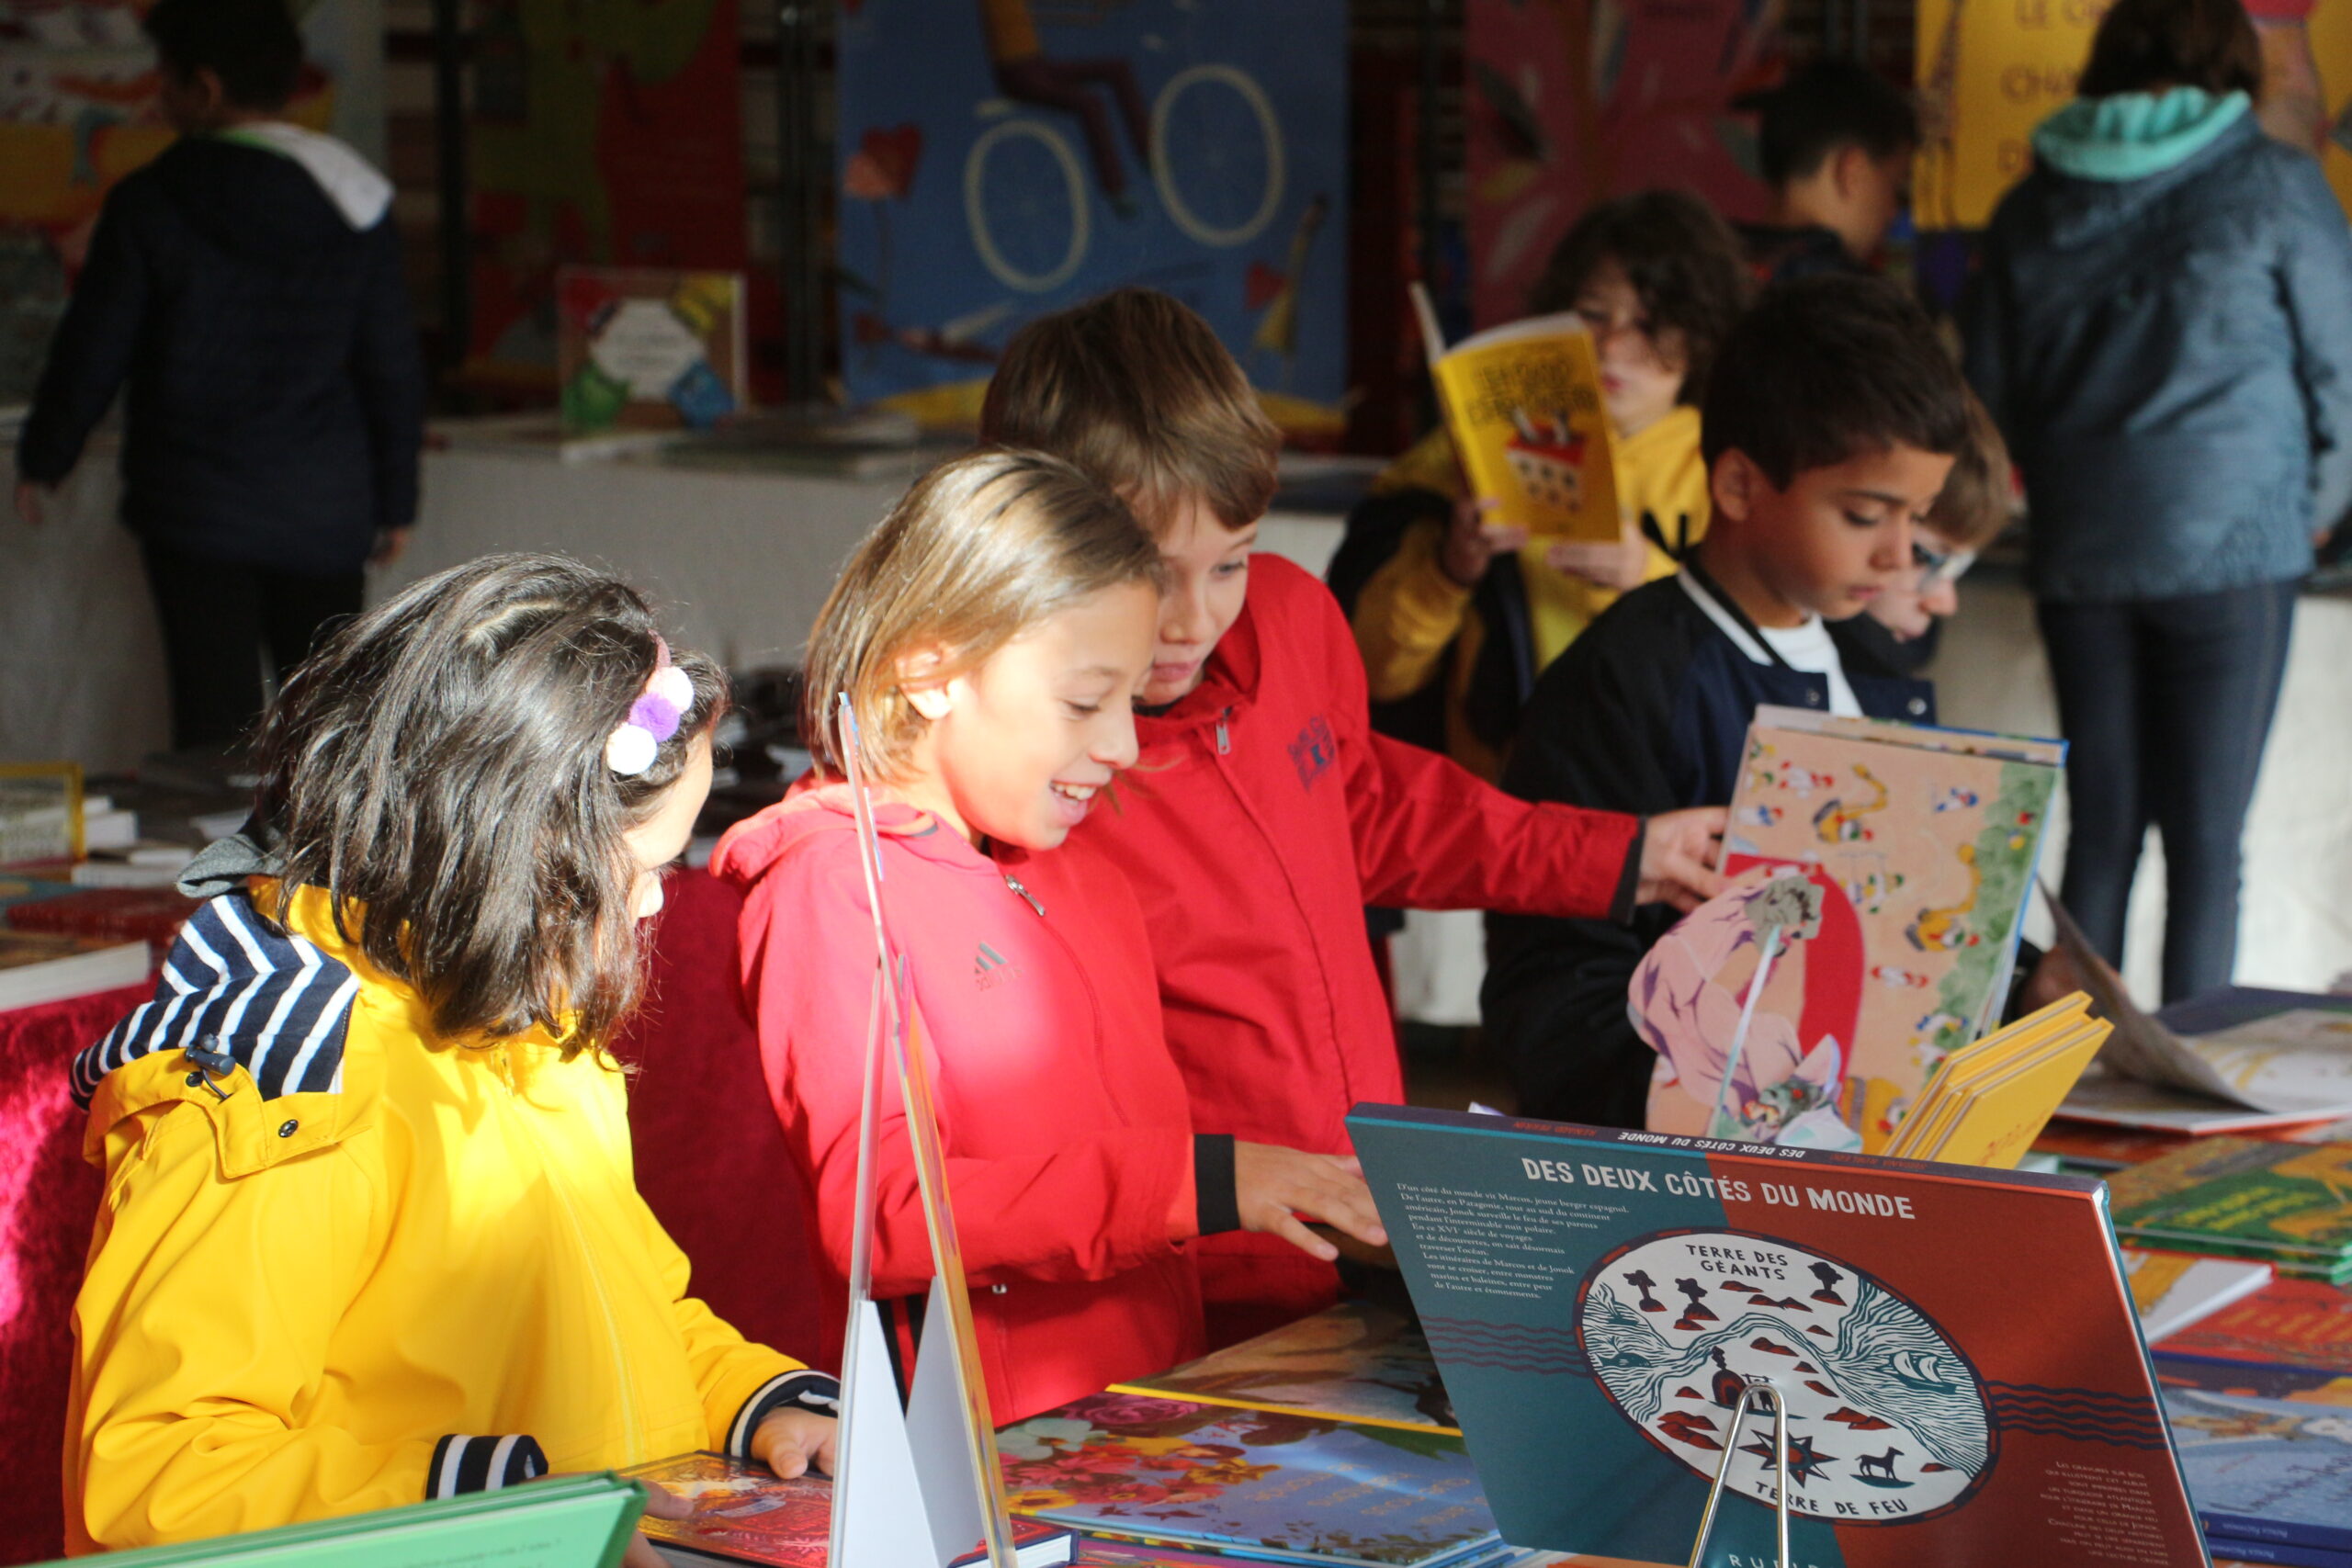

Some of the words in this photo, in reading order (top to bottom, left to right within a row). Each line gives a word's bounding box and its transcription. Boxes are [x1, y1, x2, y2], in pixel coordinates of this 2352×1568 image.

[1618, 1132, 1667, 1145] MONDE
[1671, 1136, 1691, 1147] DU
[1695, 1138, 1736, 1152] CÔTÉS
[1739, 1145, 1777, 1156] DEUX
[1779, 1148, 1806, 1159] DES
[1521, 1157, 1574, 1181] DES
[1584, 1164, 1658, 1192] DEUX
[1665, 1170, 1749, 1201] CÔTÉS
[1760, 1182, 1800, 1206] DU
[1807, 1187, 1917, 1220] MONDE
[1685, 1244, 1746, 1260] TERRE
[1753, 1251, 1789, 1266] DES
[1701, 1260, 1785, 1280] GÉANTS
[1834, 1501, 1860, 1516] DE
[1869, 1498, 1909, 1515] FEU
